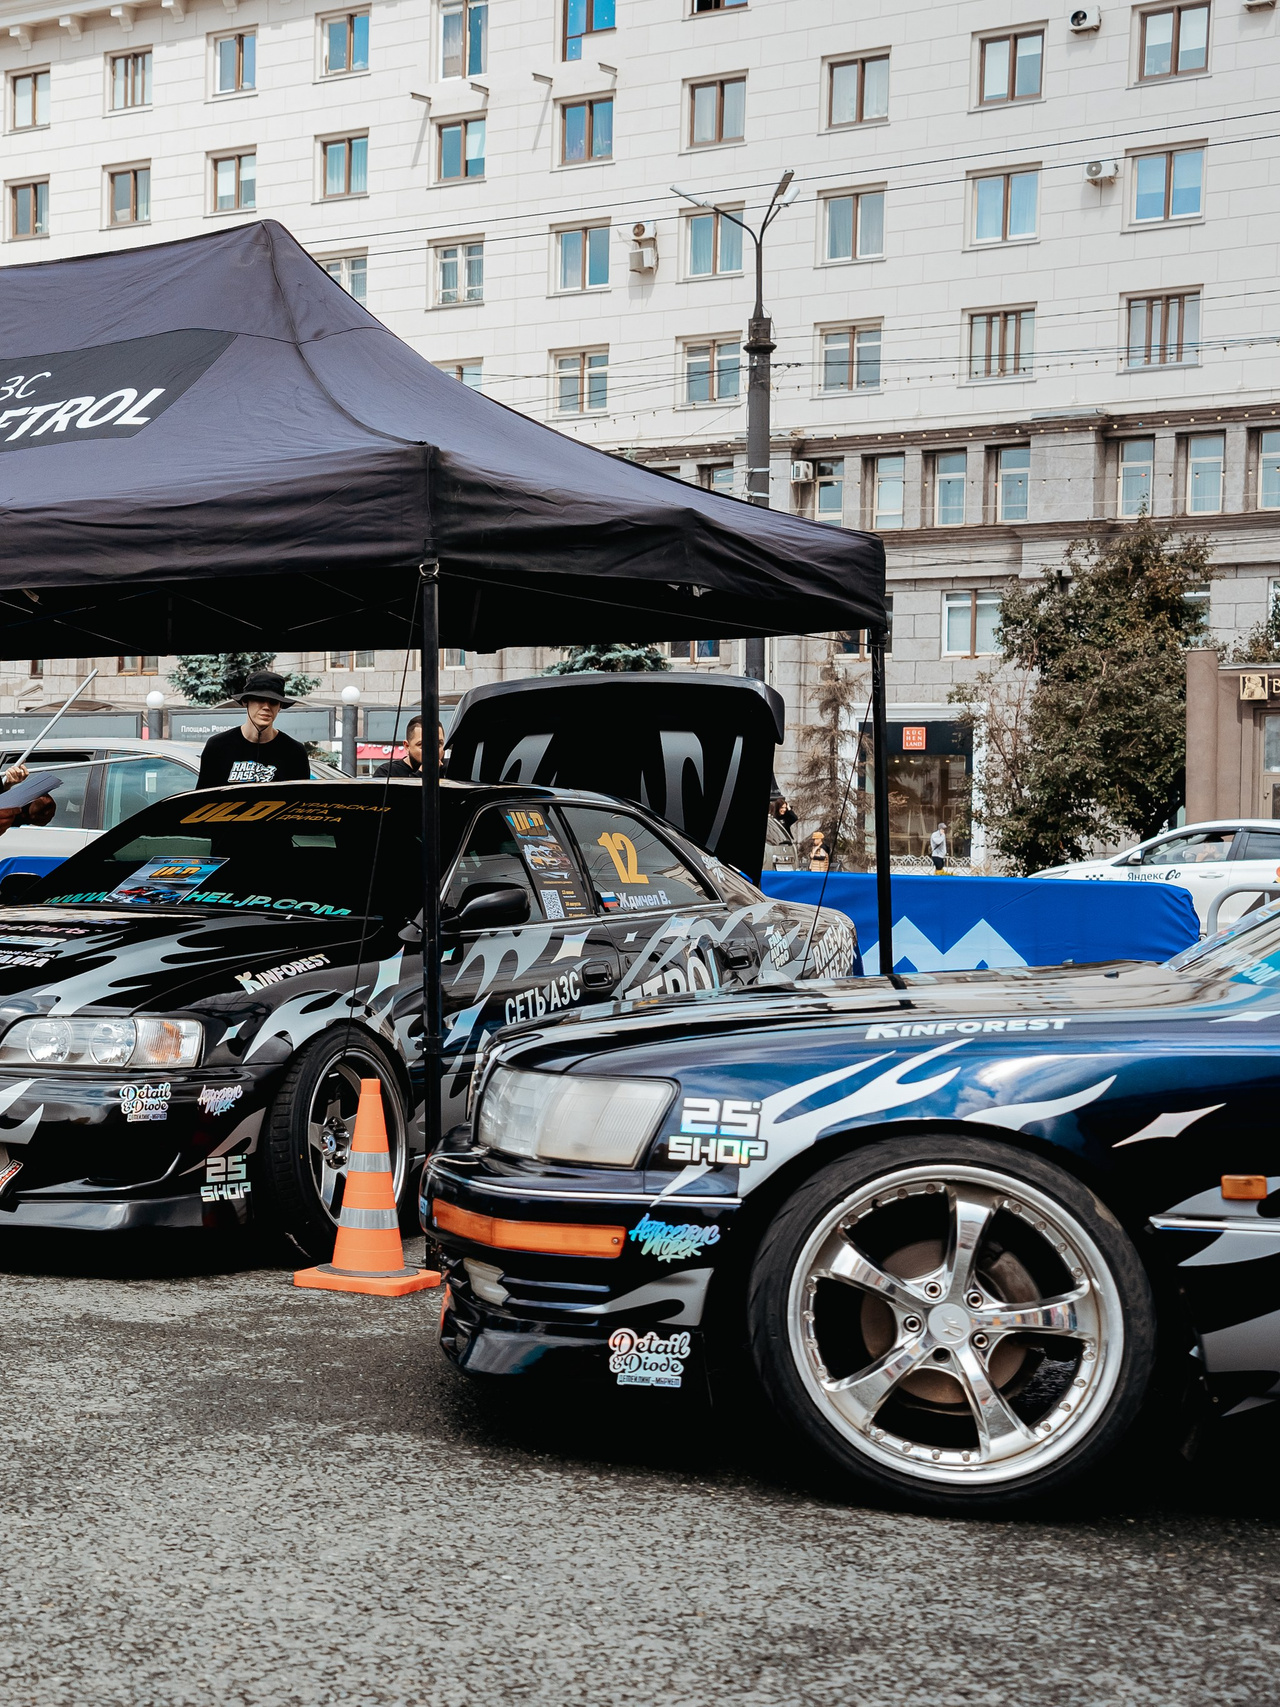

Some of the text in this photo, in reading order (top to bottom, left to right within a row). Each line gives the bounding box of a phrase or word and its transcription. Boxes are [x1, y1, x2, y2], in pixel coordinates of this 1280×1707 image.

[228, 771, 255, 782] BASE
[231, 761, 256, 772] RACE
[180, 801, 286, 824] ULD
[300, 802, 391, 813] УРАЛЬСКАЯ
[276, 815, 342, 824] ДРИФТА
[597, 832, 649, 884] 12
[1127, 869, 1181, 881] Яндекс Go
[235, 954, 331, 995] KINFOREST
[505, 971, 582, 1026] СЕТЬ АЗС
[865, 1018, 1072, 1039] KINFOREST
[120, 1083, 172, 1101] Detail
[668, 1135, 767, 1165] SHOP
[200, 1182, 251, 1202] SHOP
[610, 1330, 690, 1357] Detail
